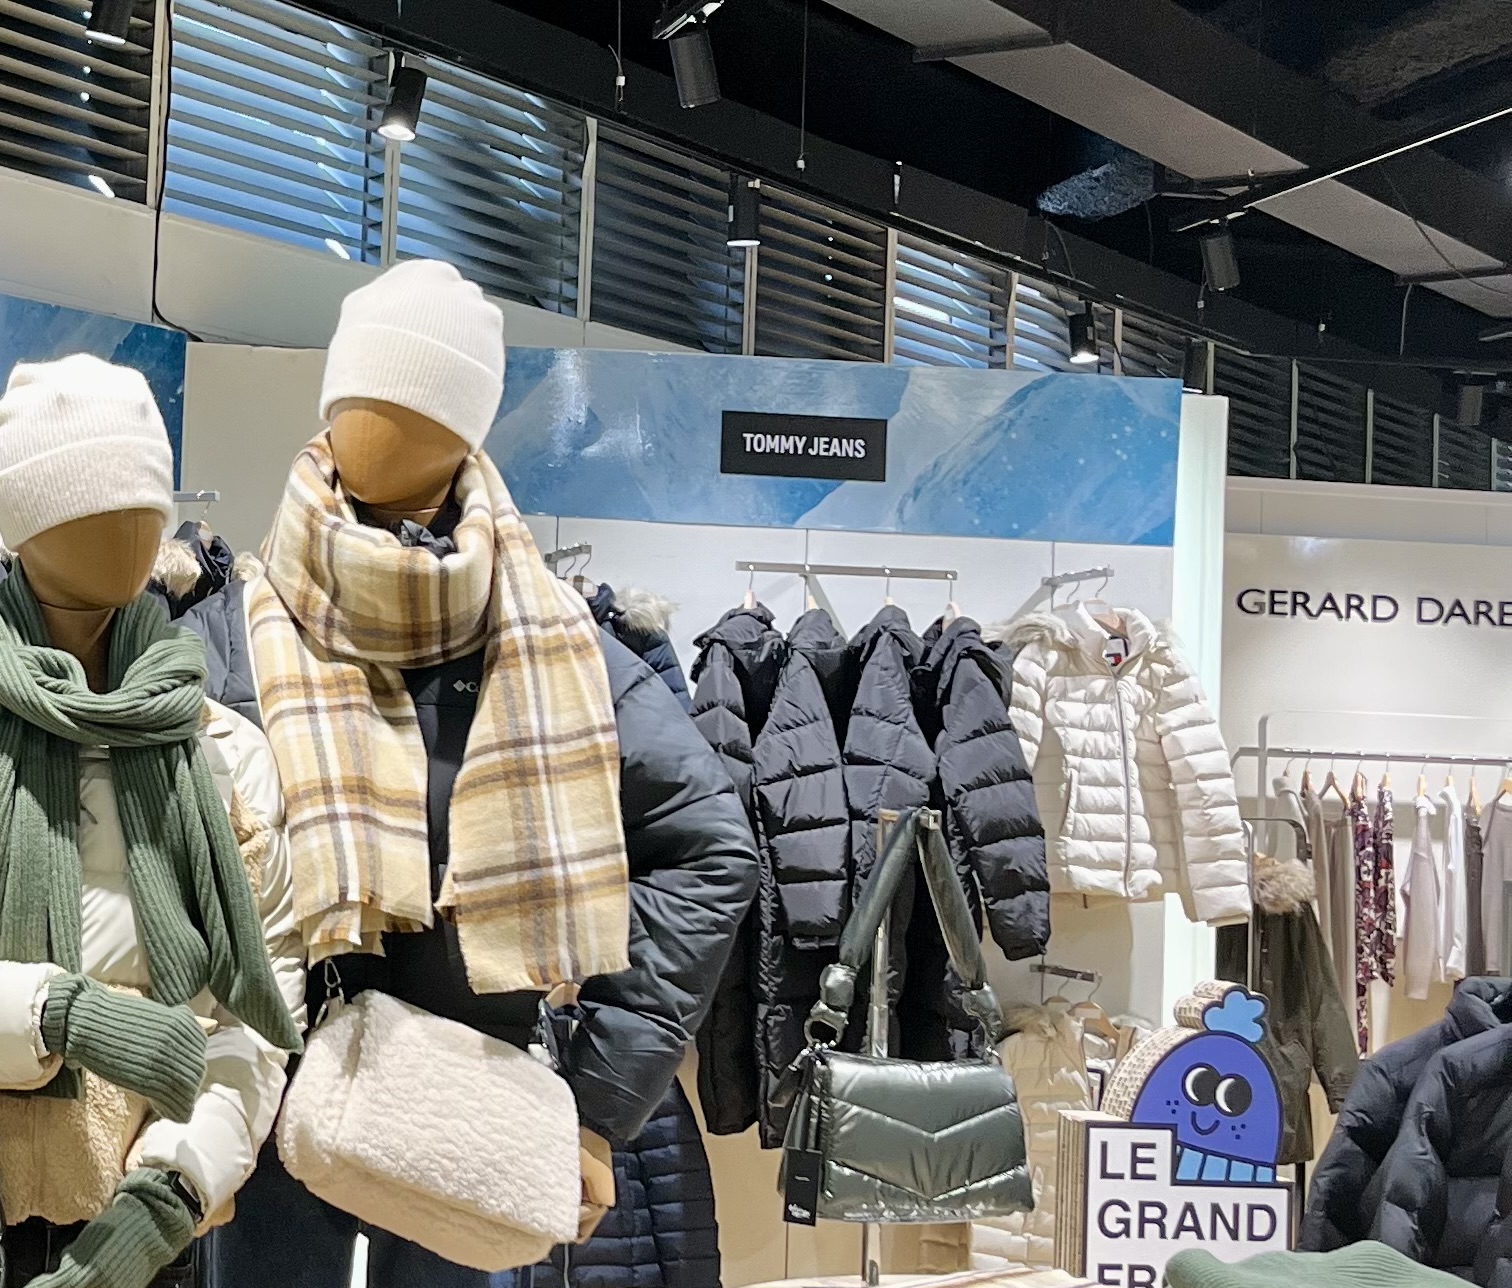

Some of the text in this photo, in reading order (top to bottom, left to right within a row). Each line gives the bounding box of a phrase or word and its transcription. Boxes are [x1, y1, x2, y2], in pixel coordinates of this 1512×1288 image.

[742, 432, 867, 459] TOMMY JEANS
[1236, 588, 1512, 627] GERARD DARE
[1099, 1140, 1157, 1181] LE
[1097, 1198, 1277, 1242] GRAND
